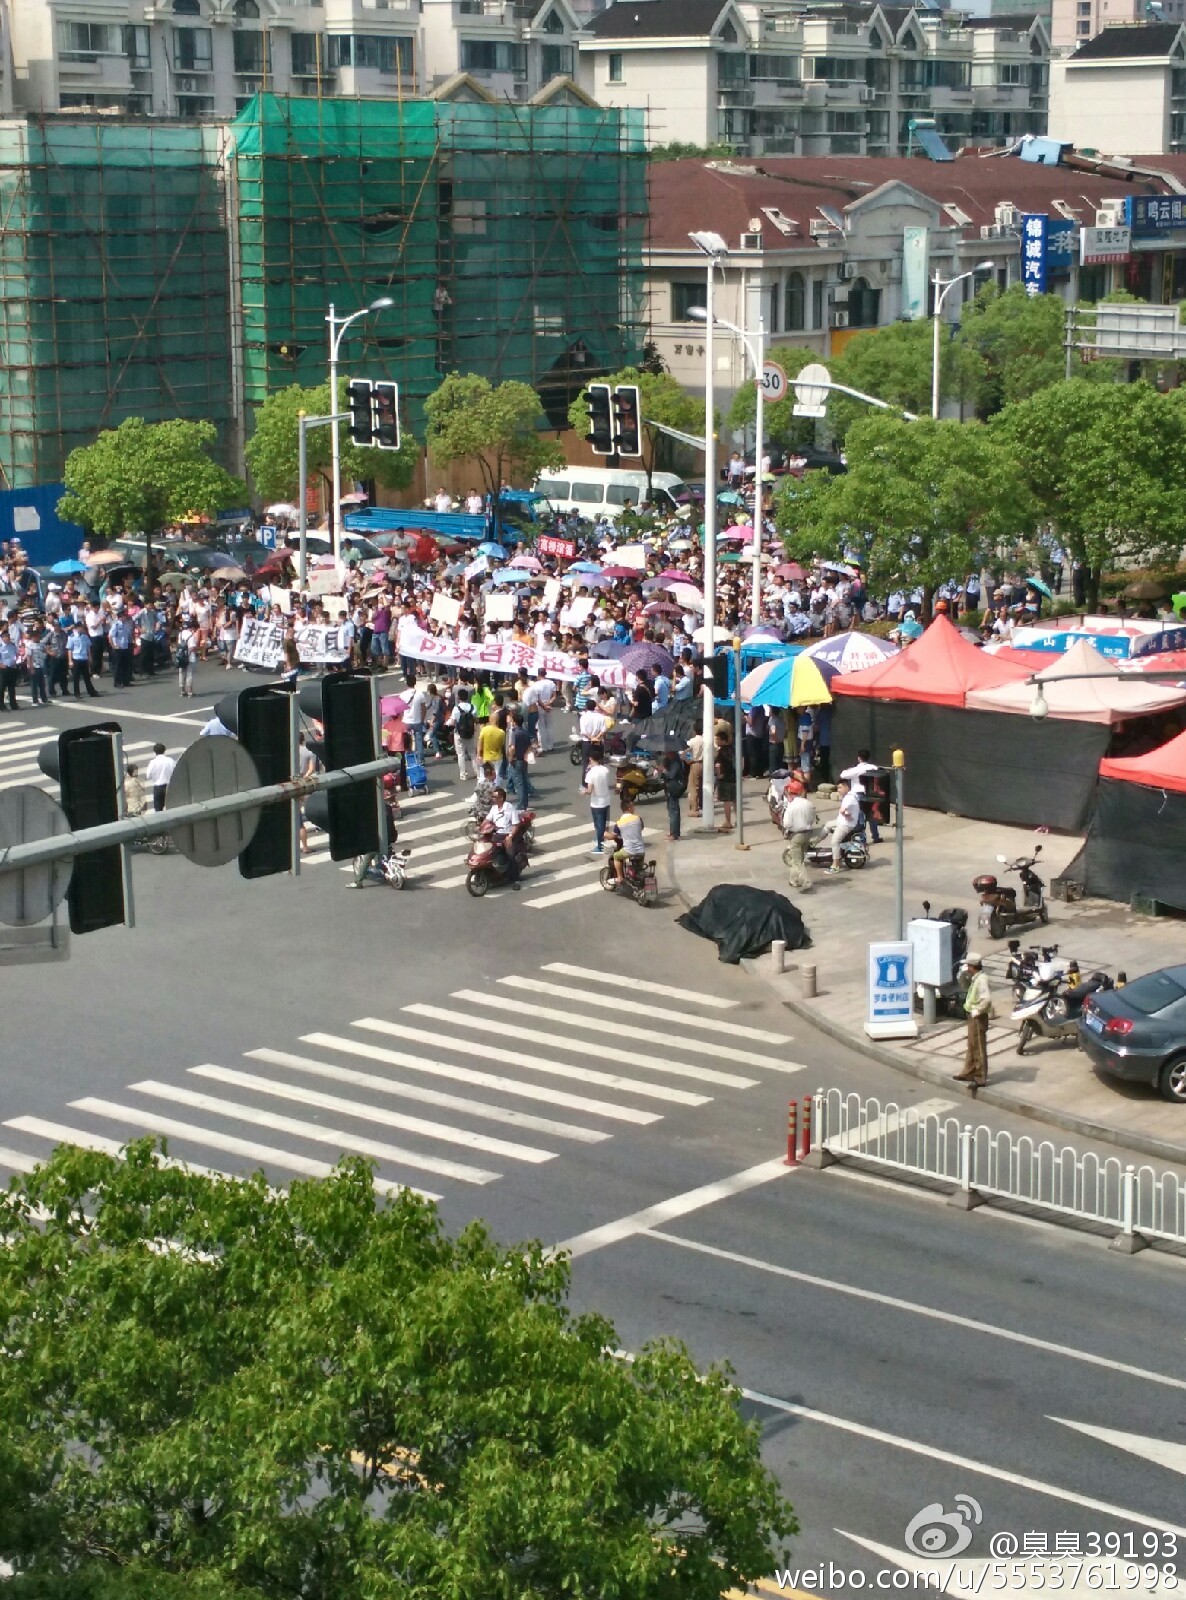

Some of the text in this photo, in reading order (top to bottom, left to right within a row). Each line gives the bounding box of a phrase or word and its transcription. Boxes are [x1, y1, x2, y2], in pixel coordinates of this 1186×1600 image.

[1025, 218, 1043, 297] 锦诚汽车
[762, 372, 780, 390] 30
[264, 529, 272, 545] P
